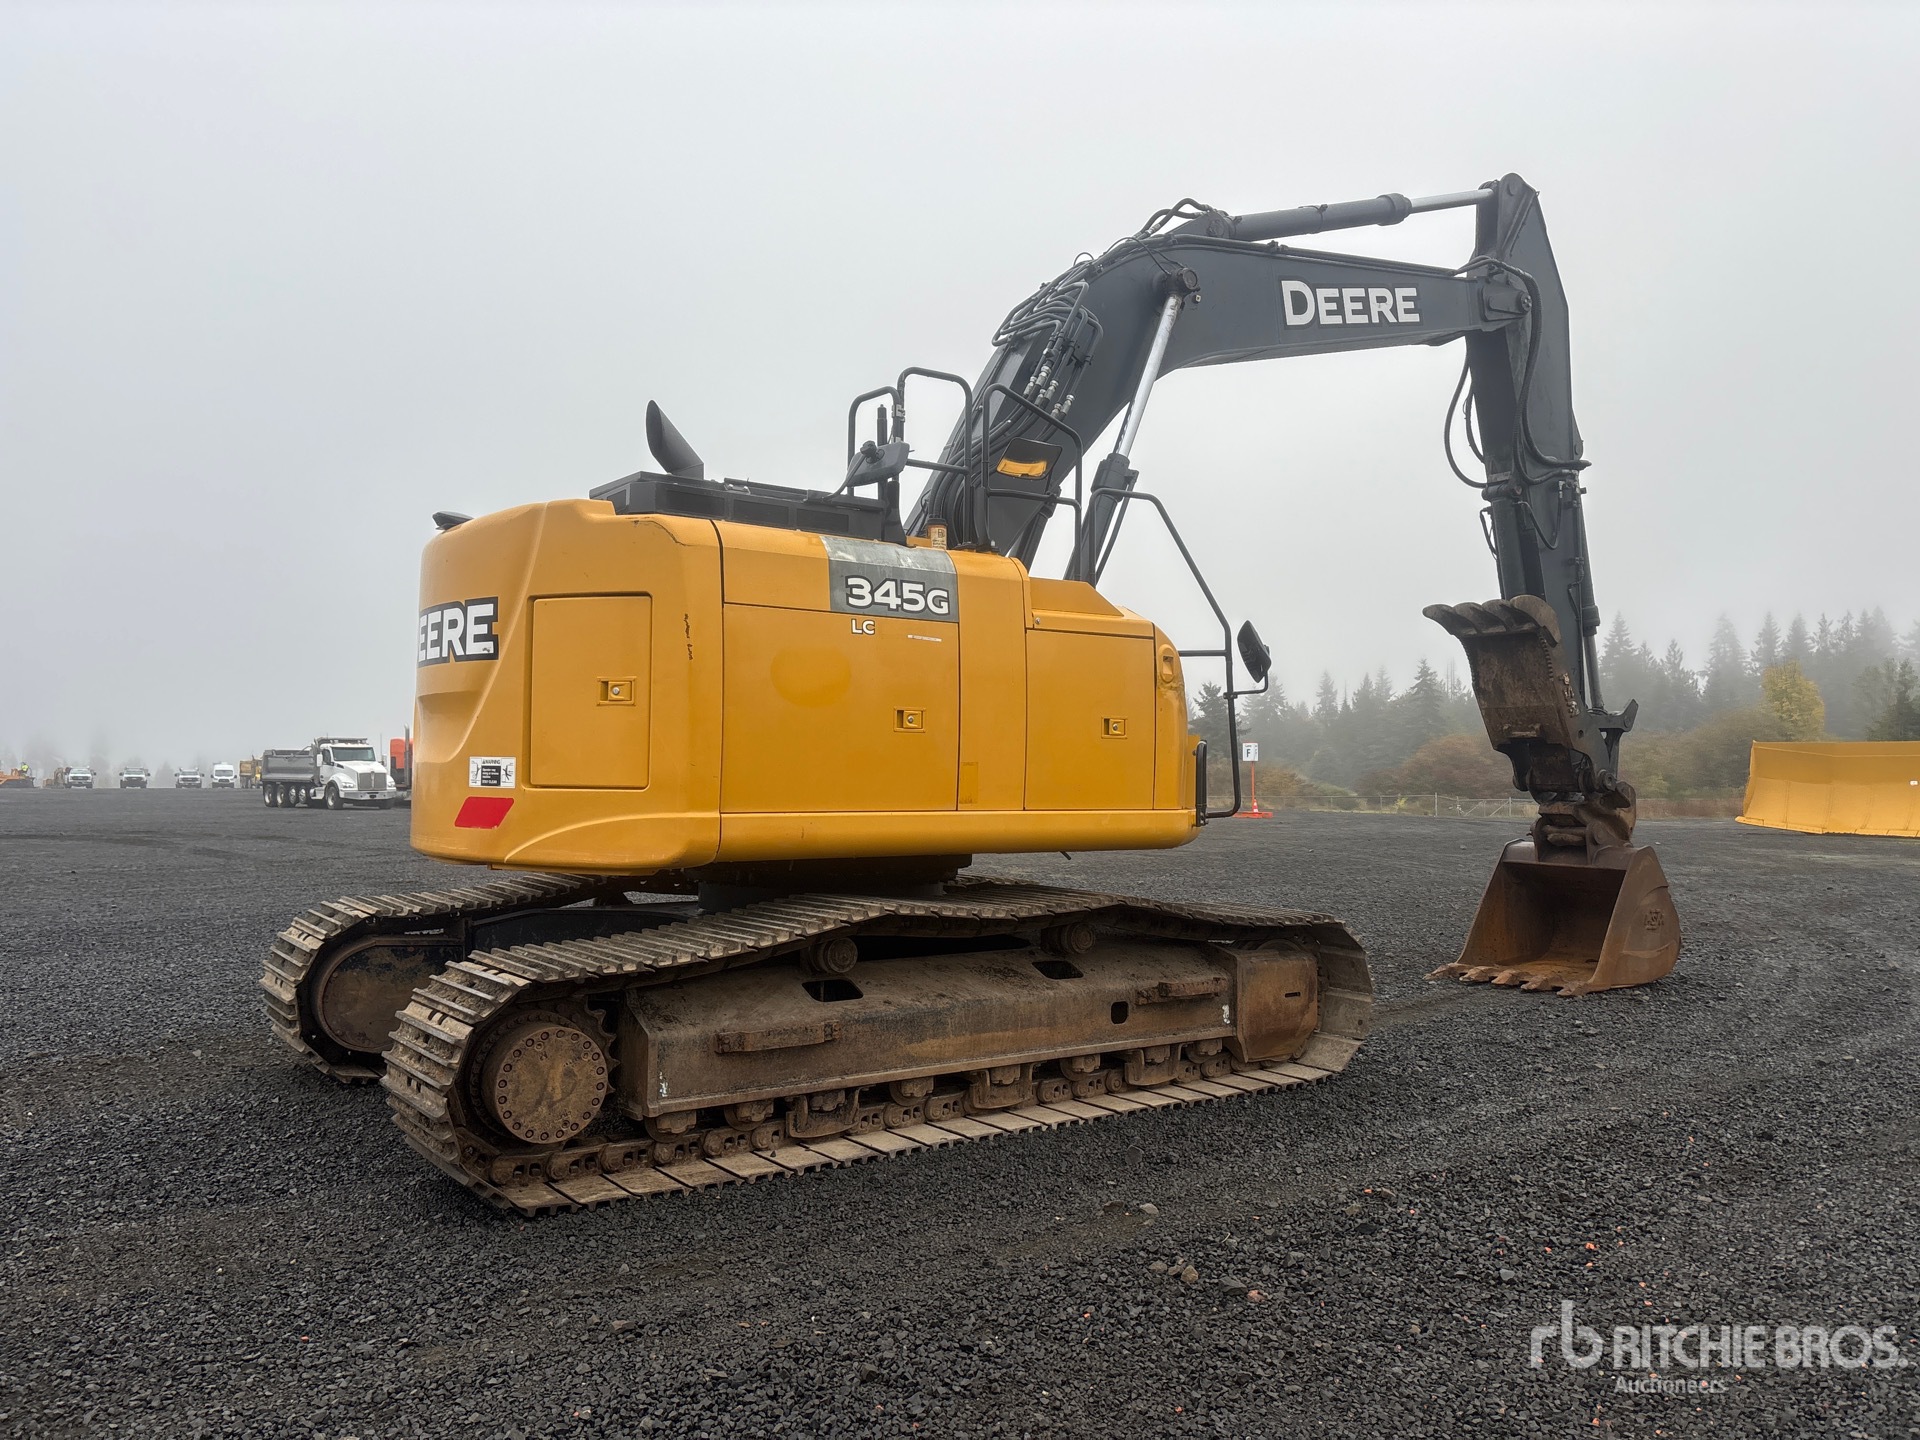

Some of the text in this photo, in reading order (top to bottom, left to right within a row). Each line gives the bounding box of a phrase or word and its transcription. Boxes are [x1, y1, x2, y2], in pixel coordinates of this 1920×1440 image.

[1281, 280, 1420, 326] DEERE
[846, 576, 950, 615] 345G
[418, 603, 494, 662] EERE
[851, 619, 875, 635] LC
